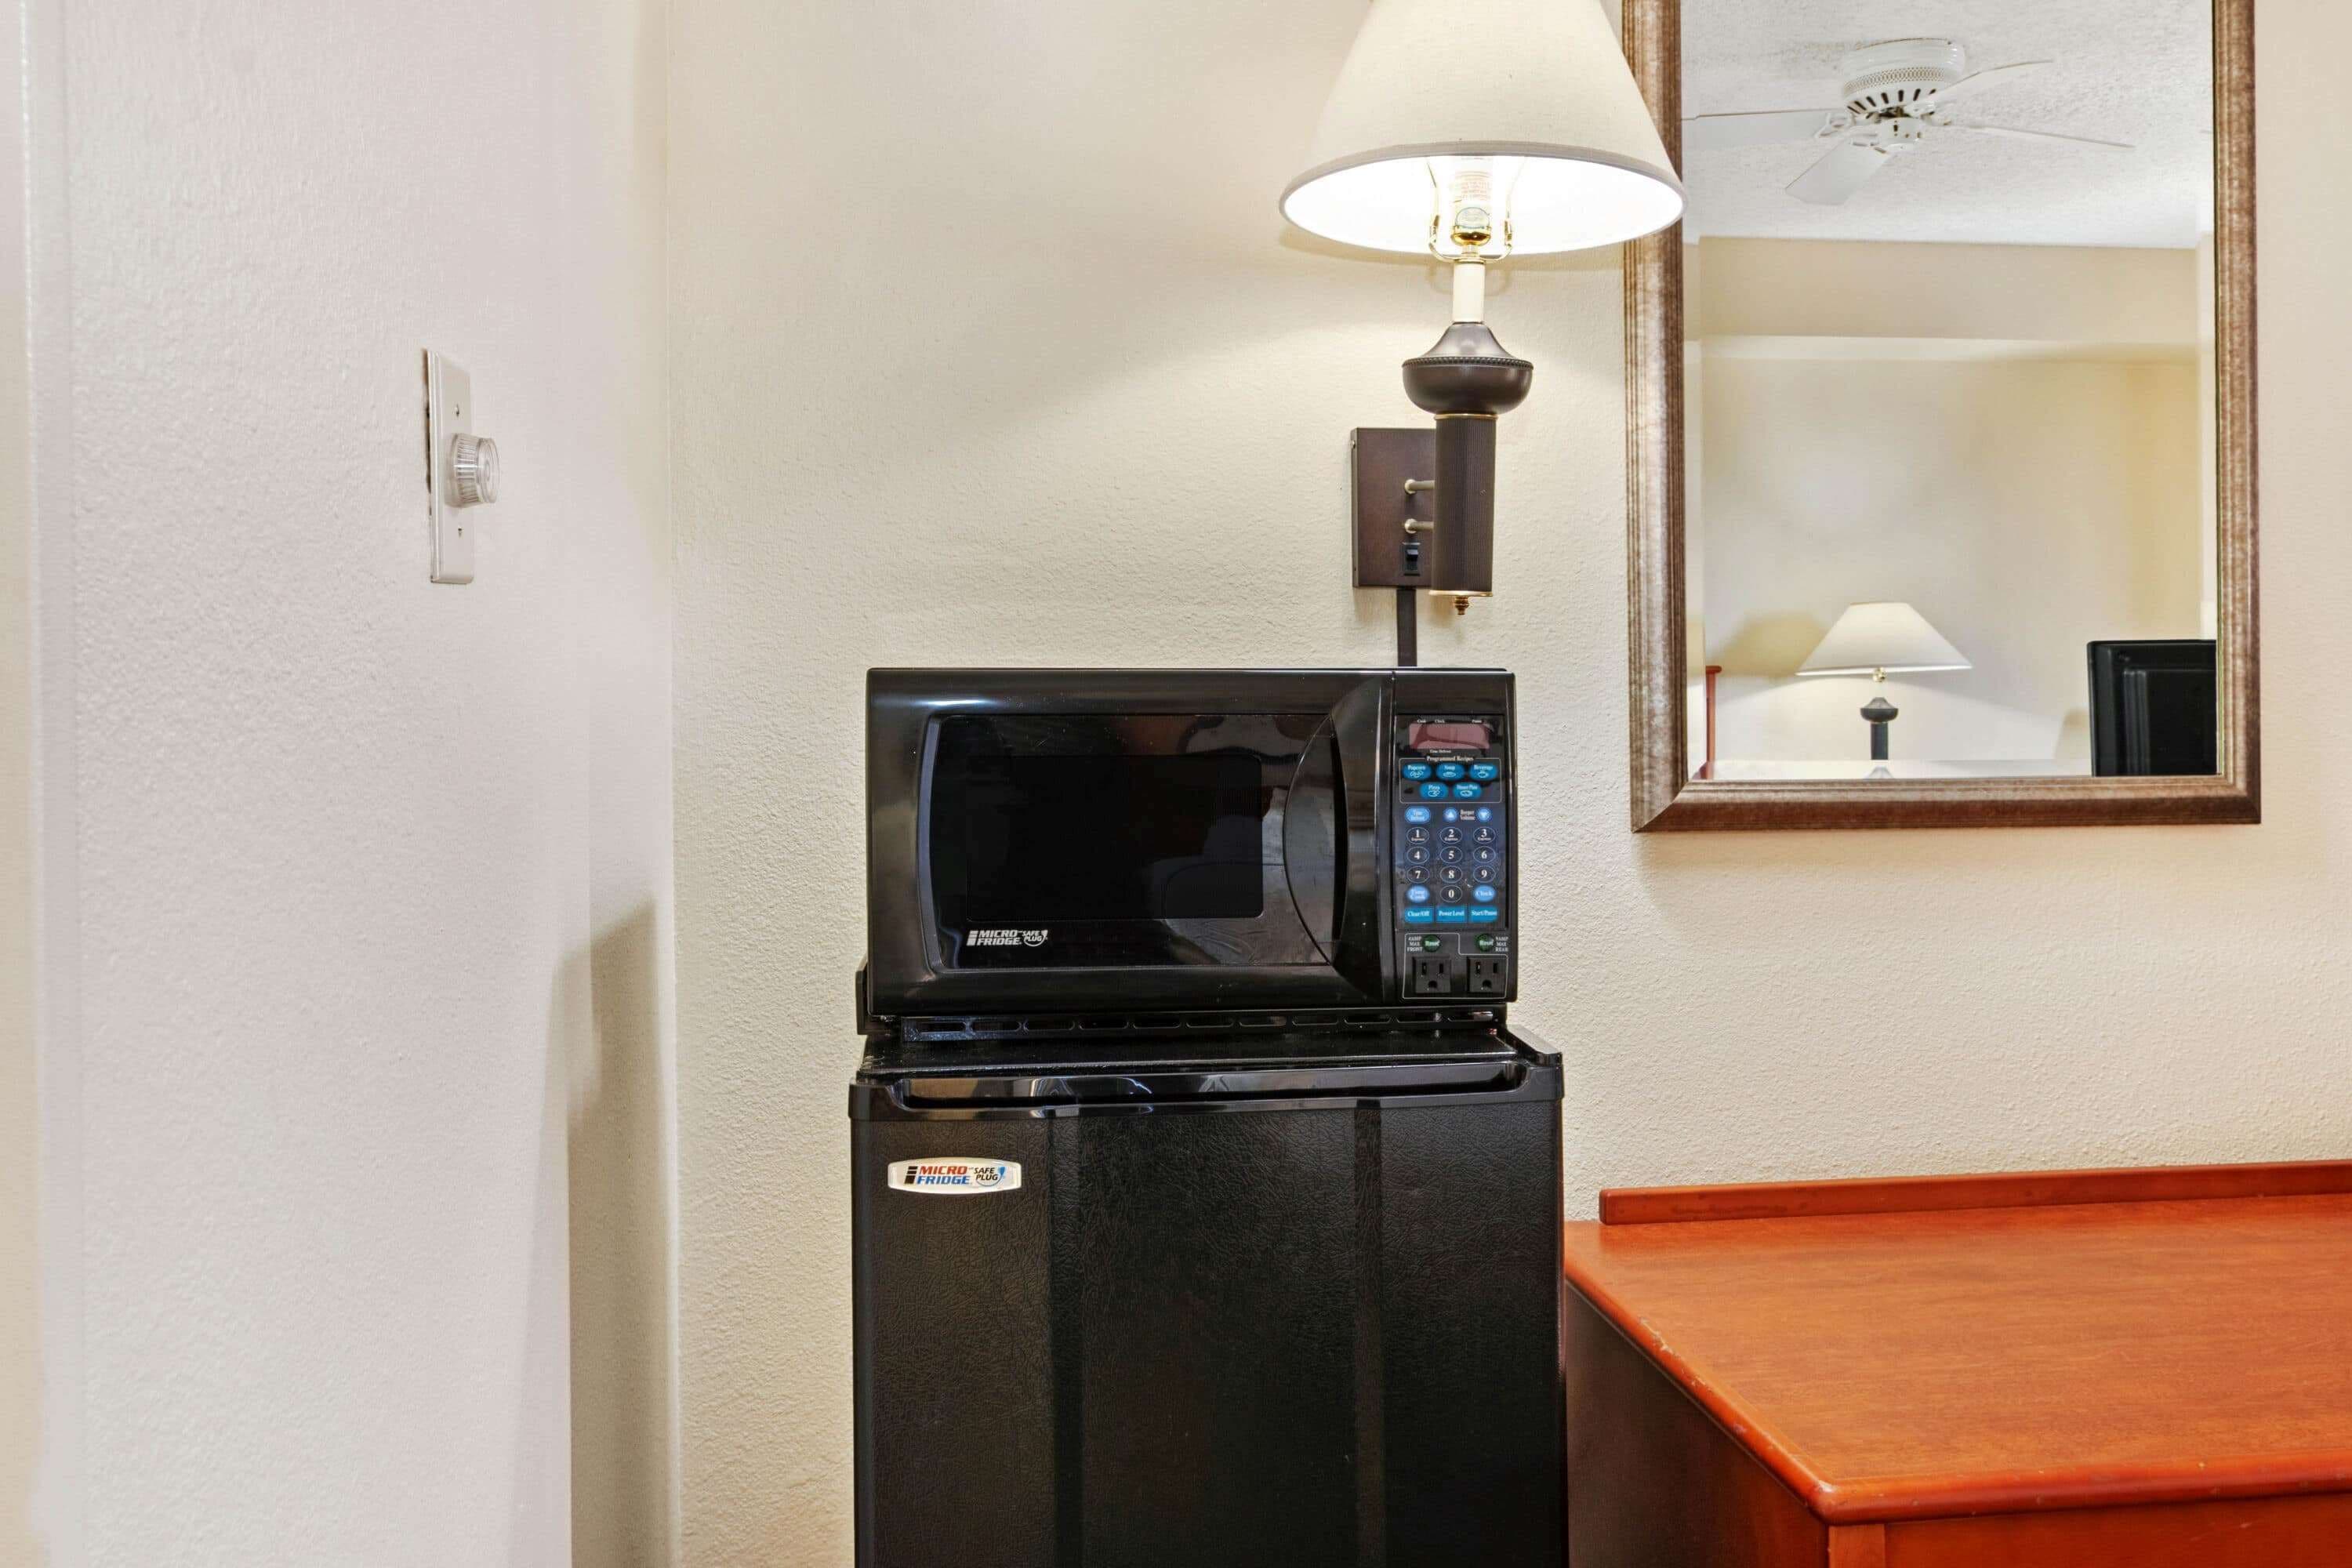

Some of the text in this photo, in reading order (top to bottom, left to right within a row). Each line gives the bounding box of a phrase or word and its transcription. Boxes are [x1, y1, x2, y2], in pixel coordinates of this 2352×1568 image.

[1416, 829, 1420, 838] 1
[1448, 829, 1455, 838] 2
[1481, 829, 1487, 838] 3
[1414, 851, 1421, 859] 4
[1448, 851, 1454, 859] 5
[1481, 851, 1487, 859] 6
[1414, 870, 1421, 879] 7
[1448, 870, 1454, 879] 8
[1481, 869, 1487, 878] 9
[1448, 889, 1454, 898] 0
[920, 1166, 967, 1174] MICRO
[916, 1175, 971, 1185] FRIDGE
